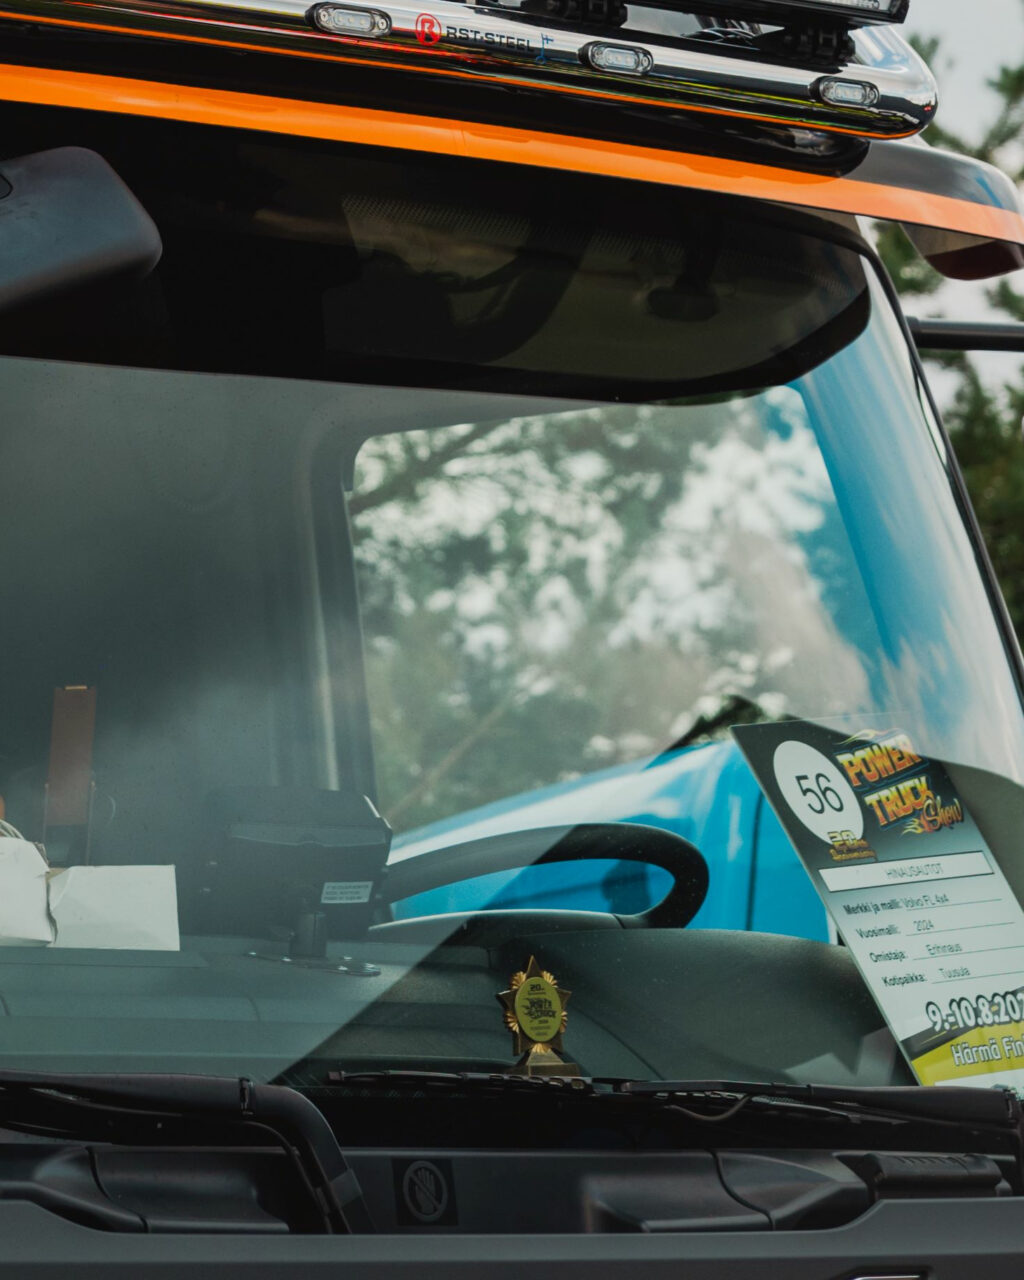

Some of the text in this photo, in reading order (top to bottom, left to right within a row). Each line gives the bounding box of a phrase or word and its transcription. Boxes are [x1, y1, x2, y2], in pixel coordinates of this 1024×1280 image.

[835, 733, 923, 787] POWER
[795, 772, 845, 814] 56
[864, 776, 933, 826] TRUCK
[842, 902, 873, 915] Merkki
[871, 903, 881, 915] ja
[951, 1032, 1024, 1066] Härmä Fin
